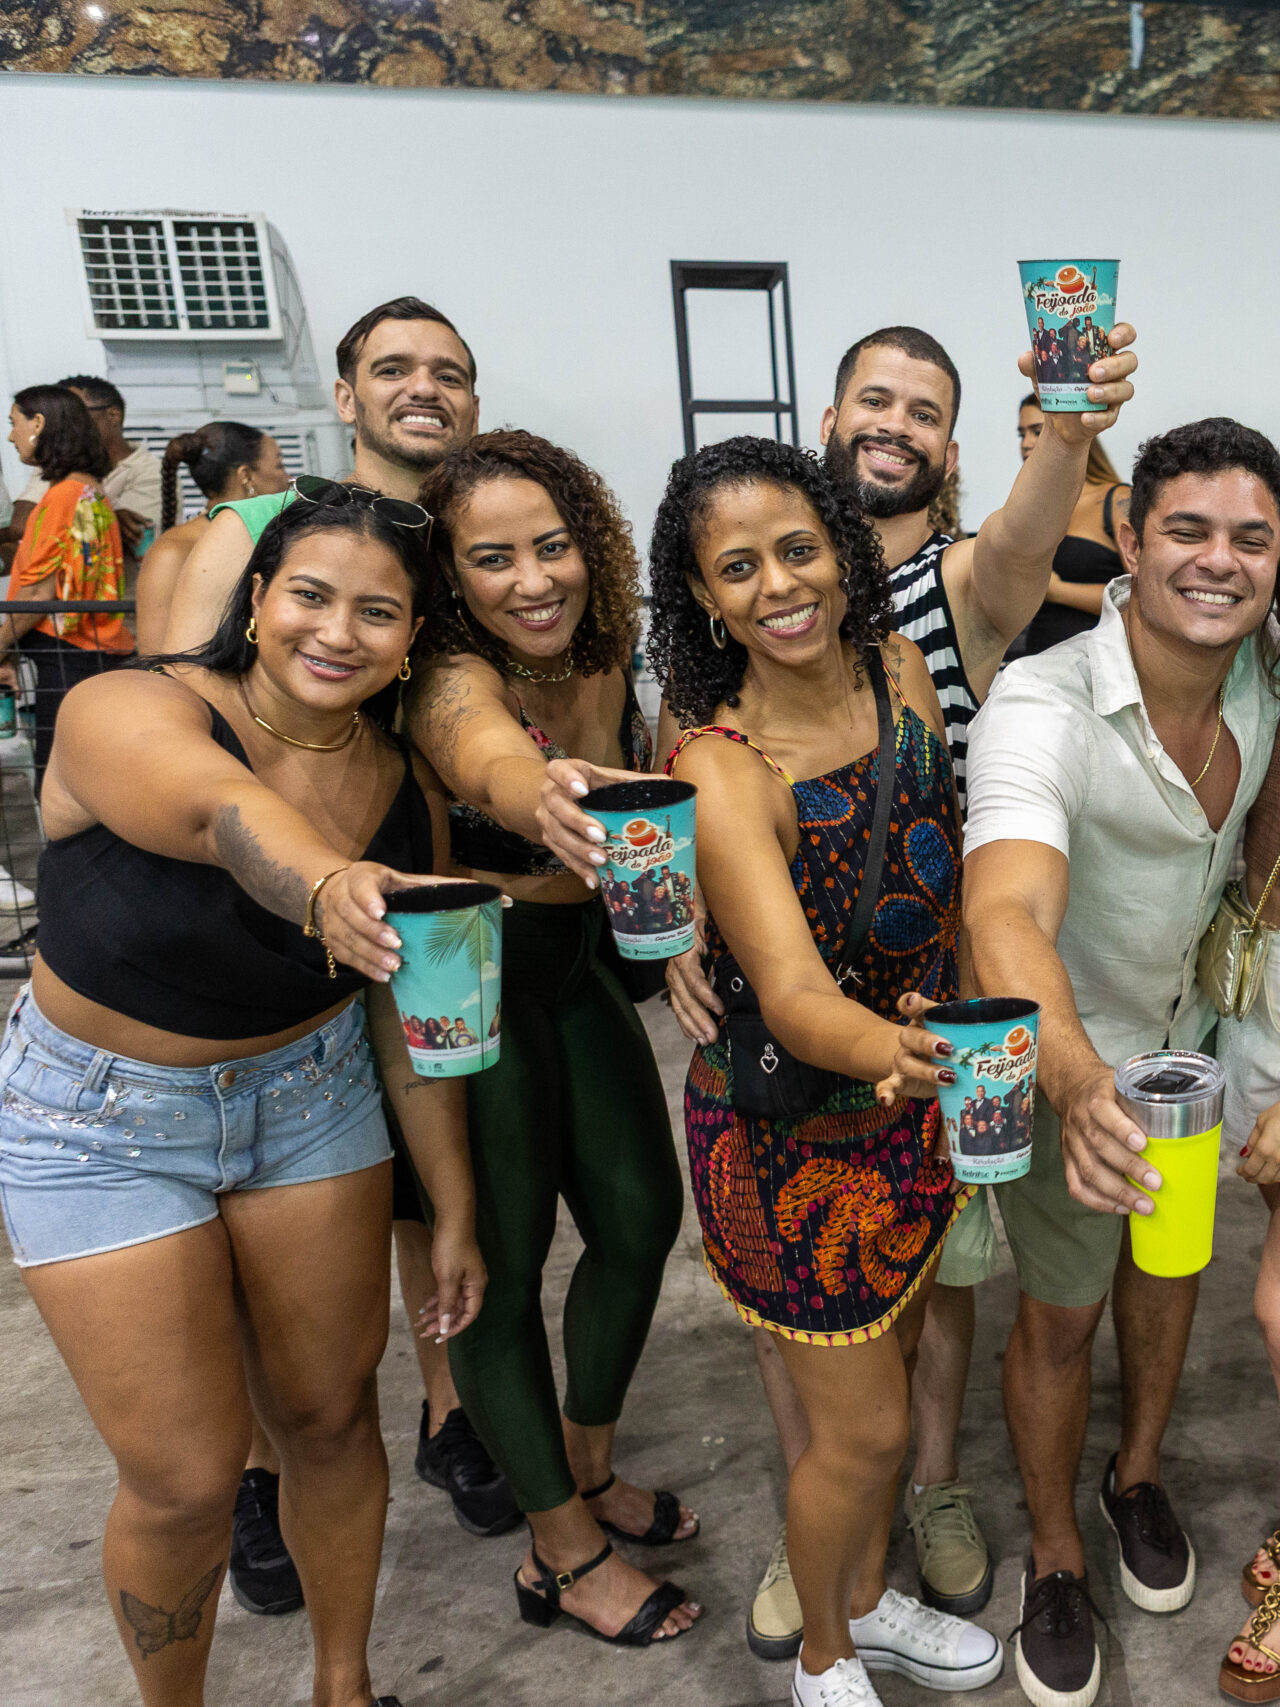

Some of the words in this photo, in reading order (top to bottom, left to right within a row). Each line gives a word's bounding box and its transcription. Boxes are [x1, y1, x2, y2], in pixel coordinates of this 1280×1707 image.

[1036, 286, 1097, 313] Feijoada
[1058, 307, 1069, 316] do
[1069, 302, 1095, 318] joão
[630, 860, 642, 869] do
[643, 852, 673, 871] joão
[976, 1041, 1036, 1079] Feijoada
[1005, 1070, 1016, 1082] do
